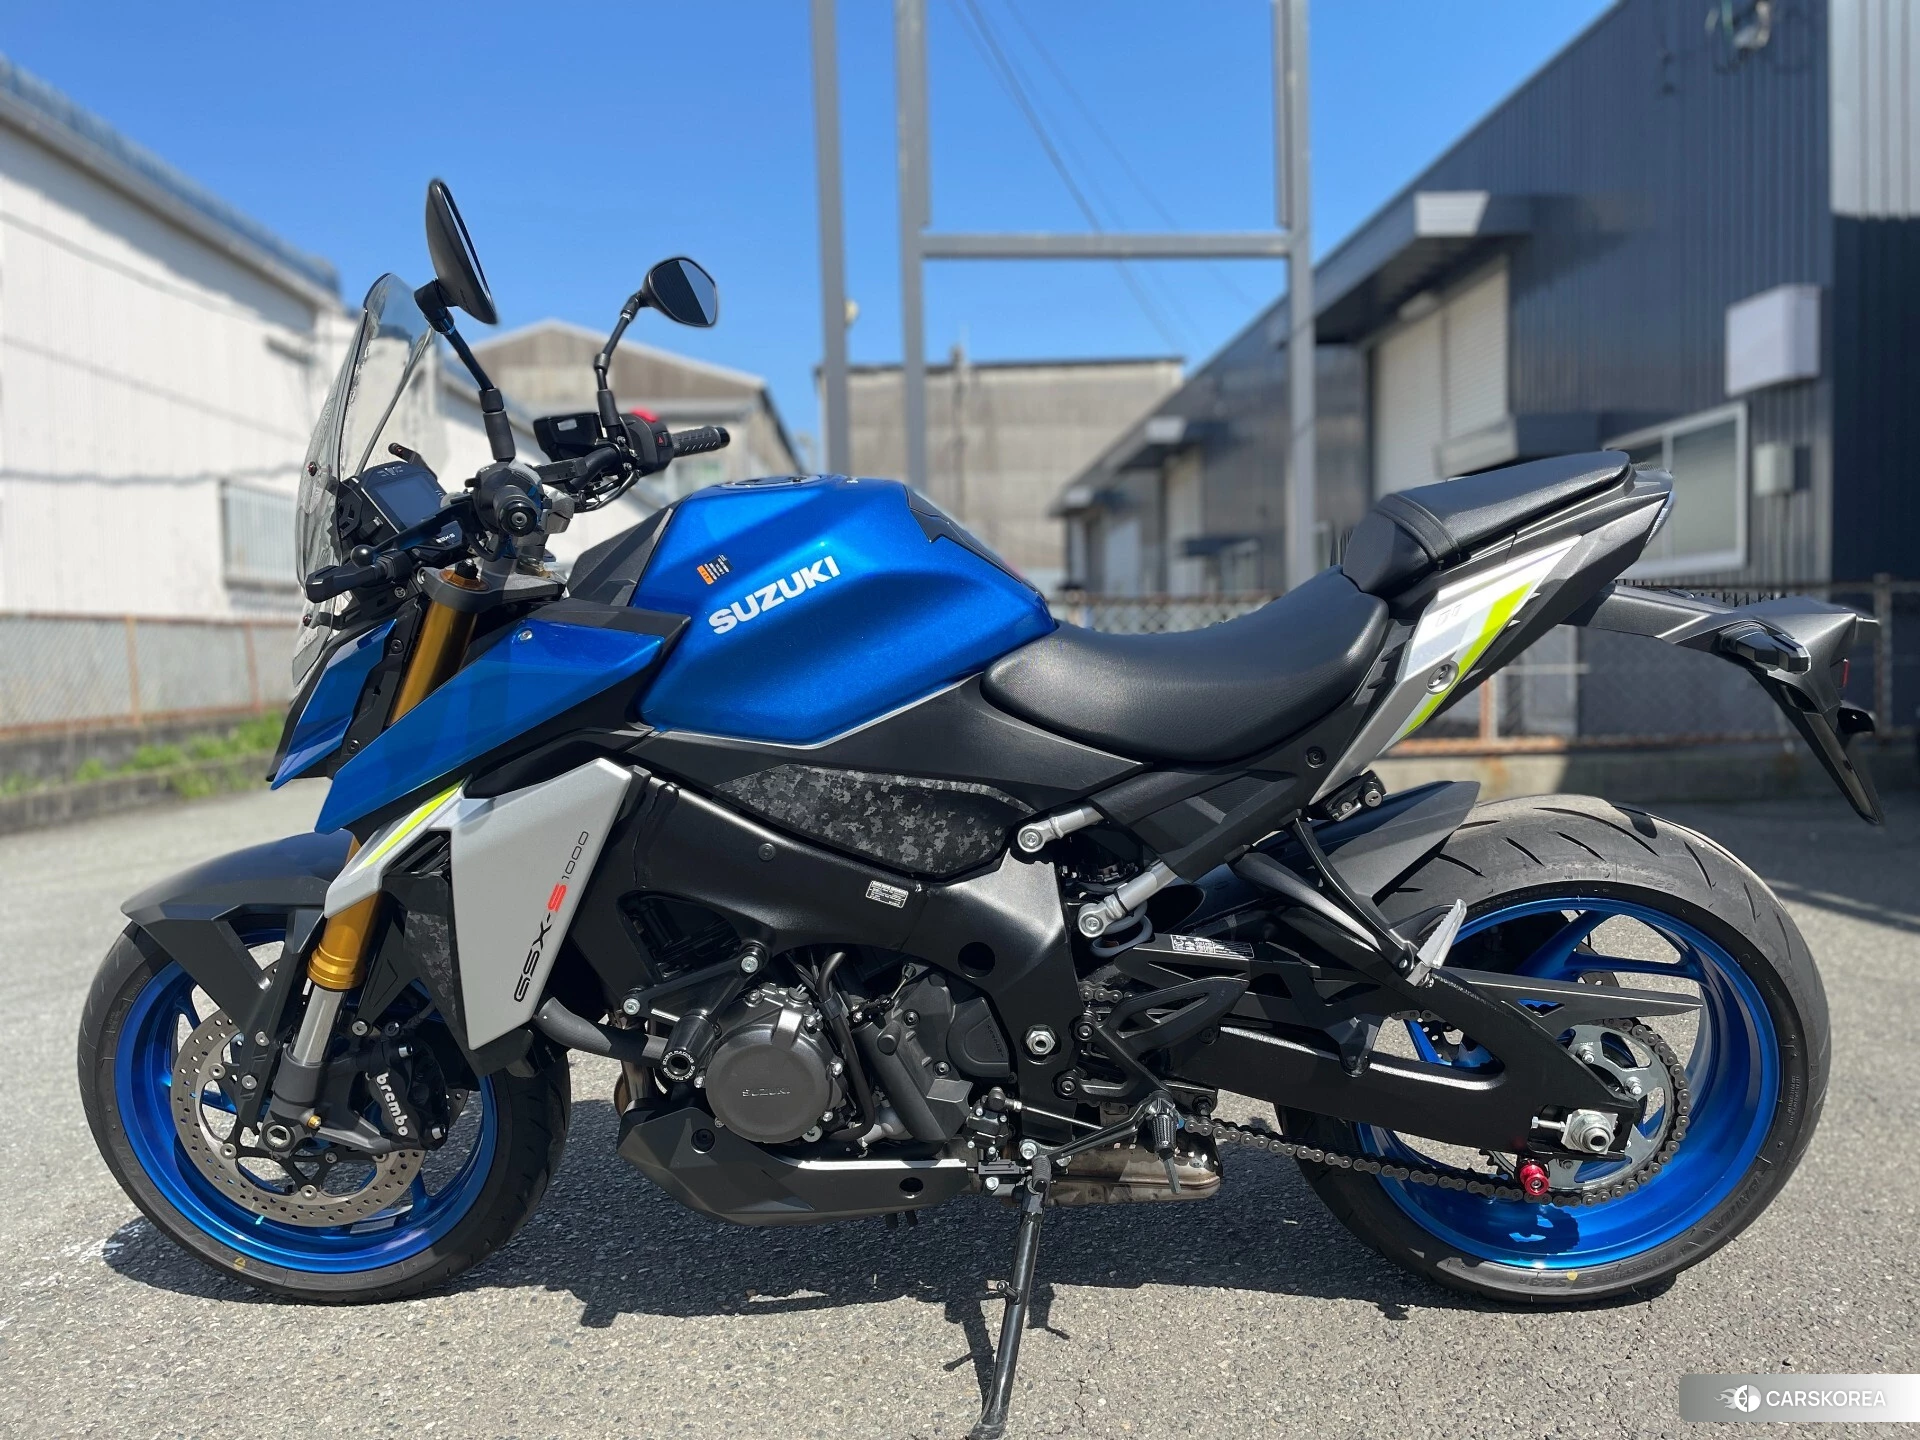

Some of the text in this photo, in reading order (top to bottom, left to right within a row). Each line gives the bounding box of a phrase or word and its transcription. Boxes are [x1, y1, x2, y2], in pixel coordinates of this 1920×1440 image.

[708, 555, 841, 634] SUZUKI
[376, 1072, 408, 1136] brembo
[742, 1087, 791, 1097] SUZUKI
